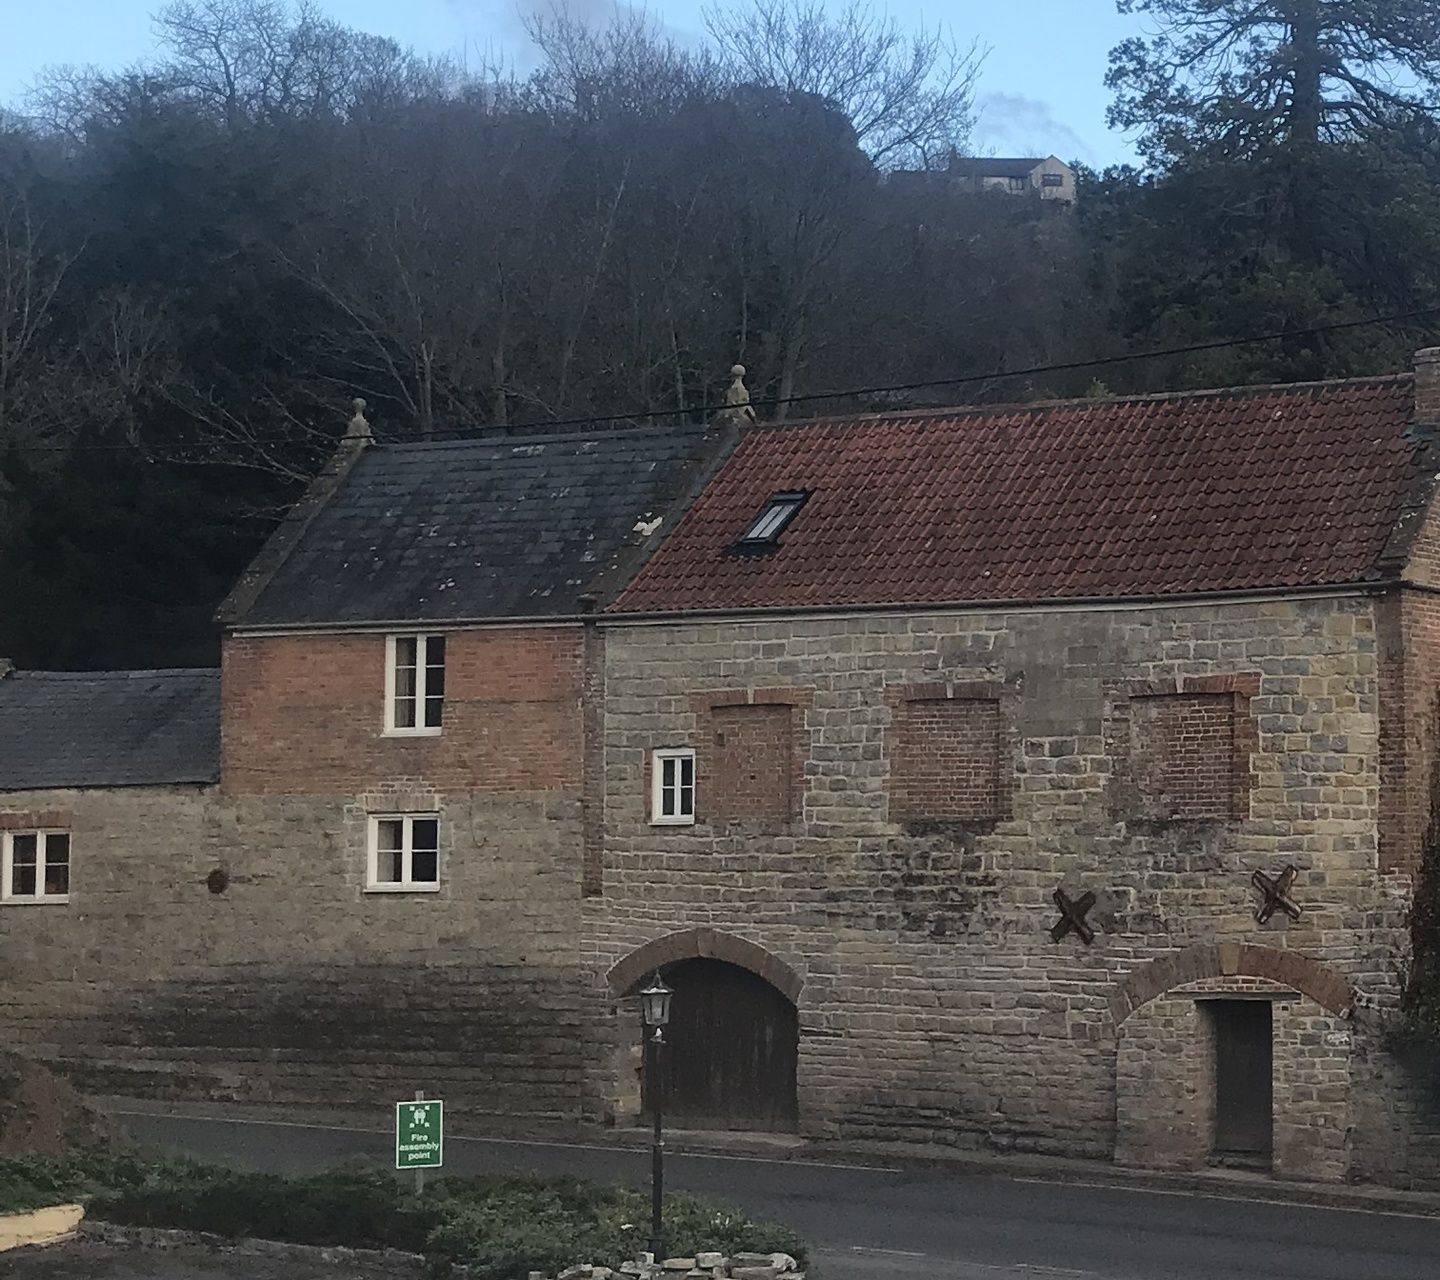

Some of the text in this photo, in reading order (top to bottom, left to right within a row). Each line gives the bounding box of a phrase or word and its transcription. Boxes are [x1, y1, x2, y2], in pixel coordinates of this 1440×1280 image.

[411, 1133, 428, 1142] Fire
[399, 1142, 439, 1151] assembly
[408, 1151, 430, 1161] point
